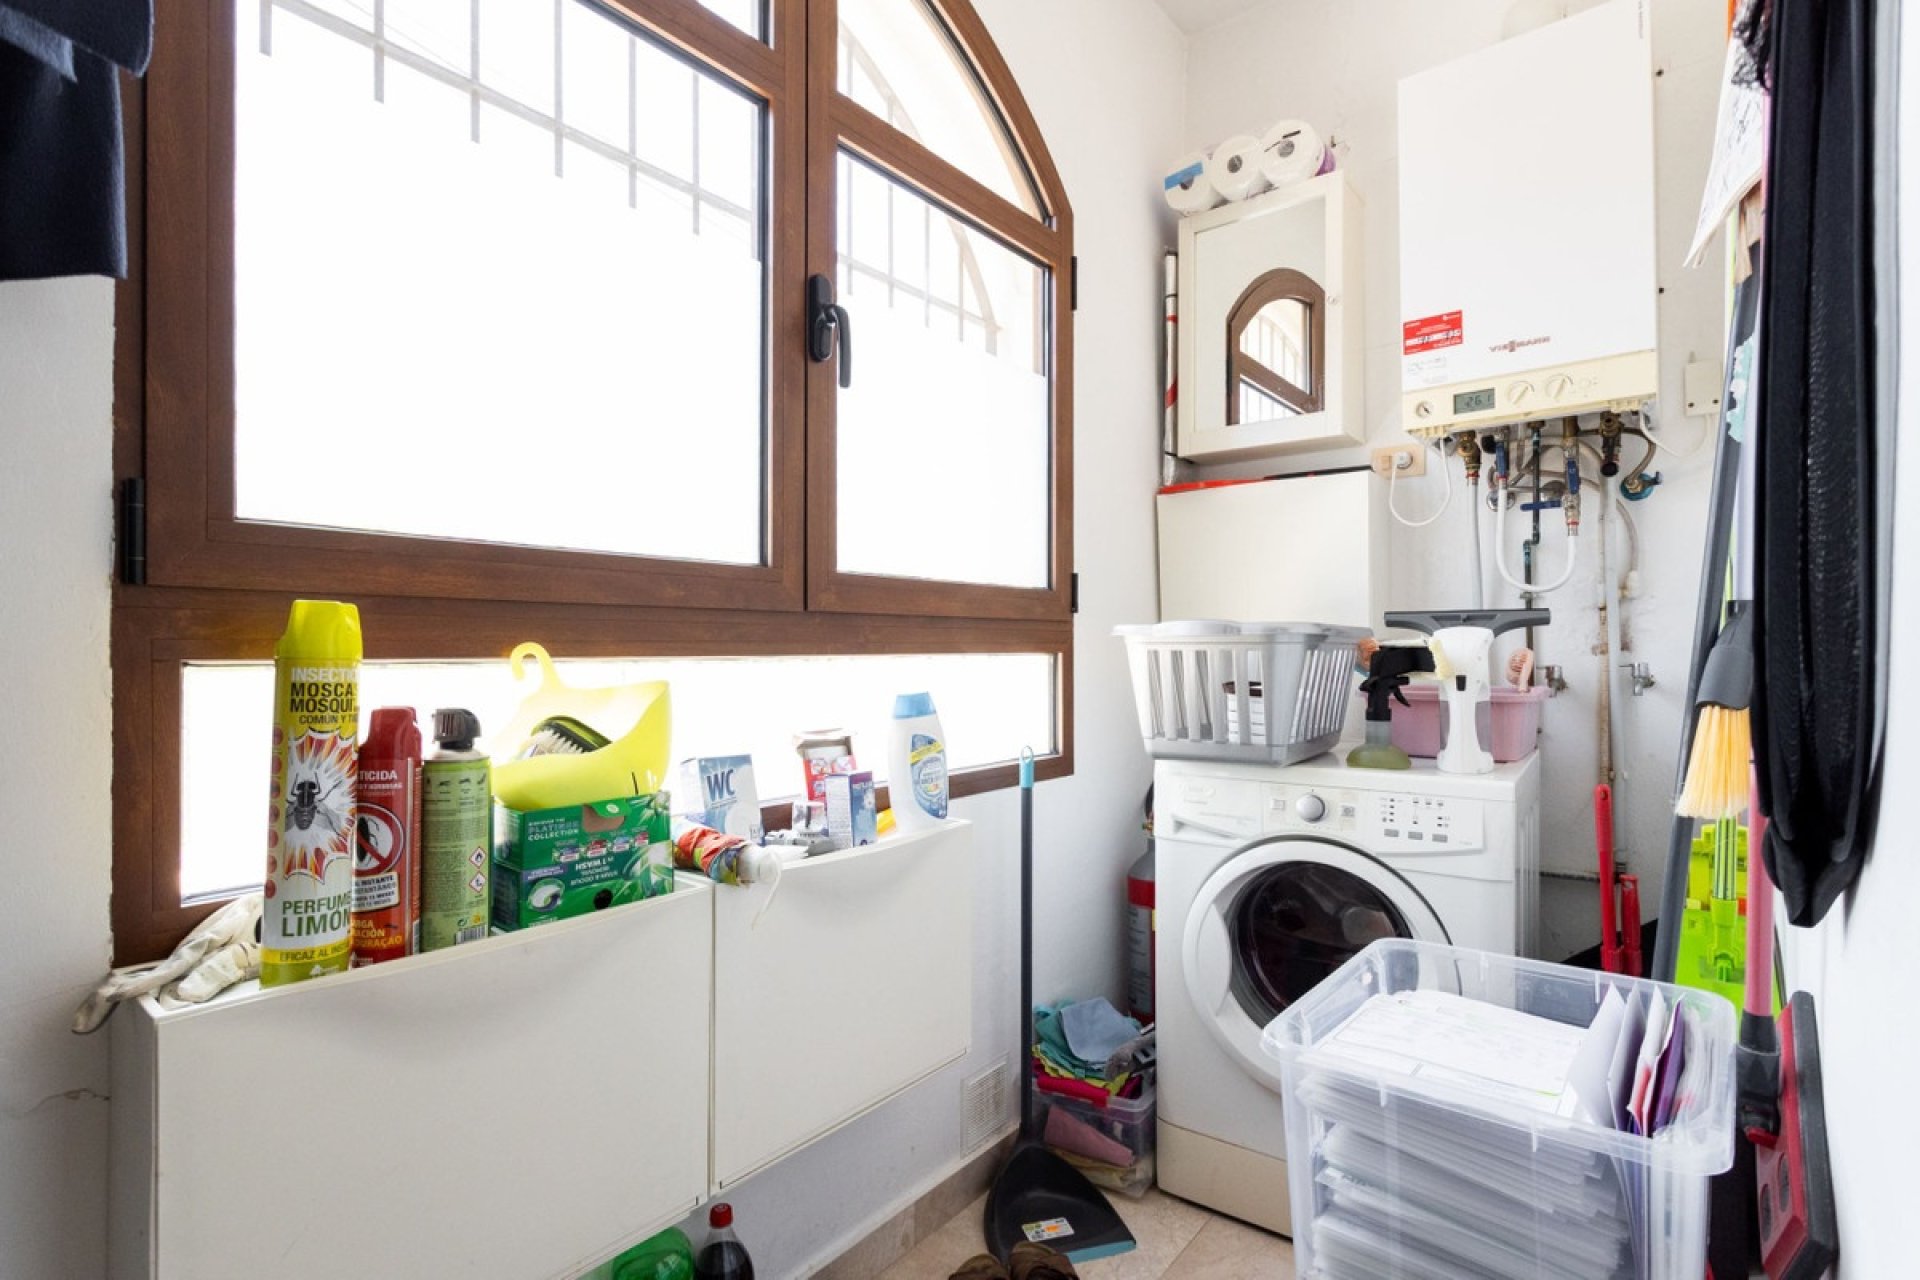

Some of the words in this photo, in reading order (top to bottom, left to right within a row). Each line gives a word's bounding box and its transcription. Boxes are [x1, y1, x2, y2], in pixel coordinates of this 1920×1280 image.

[291, 682, 357, 697] MOSCA
[290, 698, 357, 713] MOSQUI
[358, 769, 398, 781] TICIDA
[706, 768, 735, 802] WC
